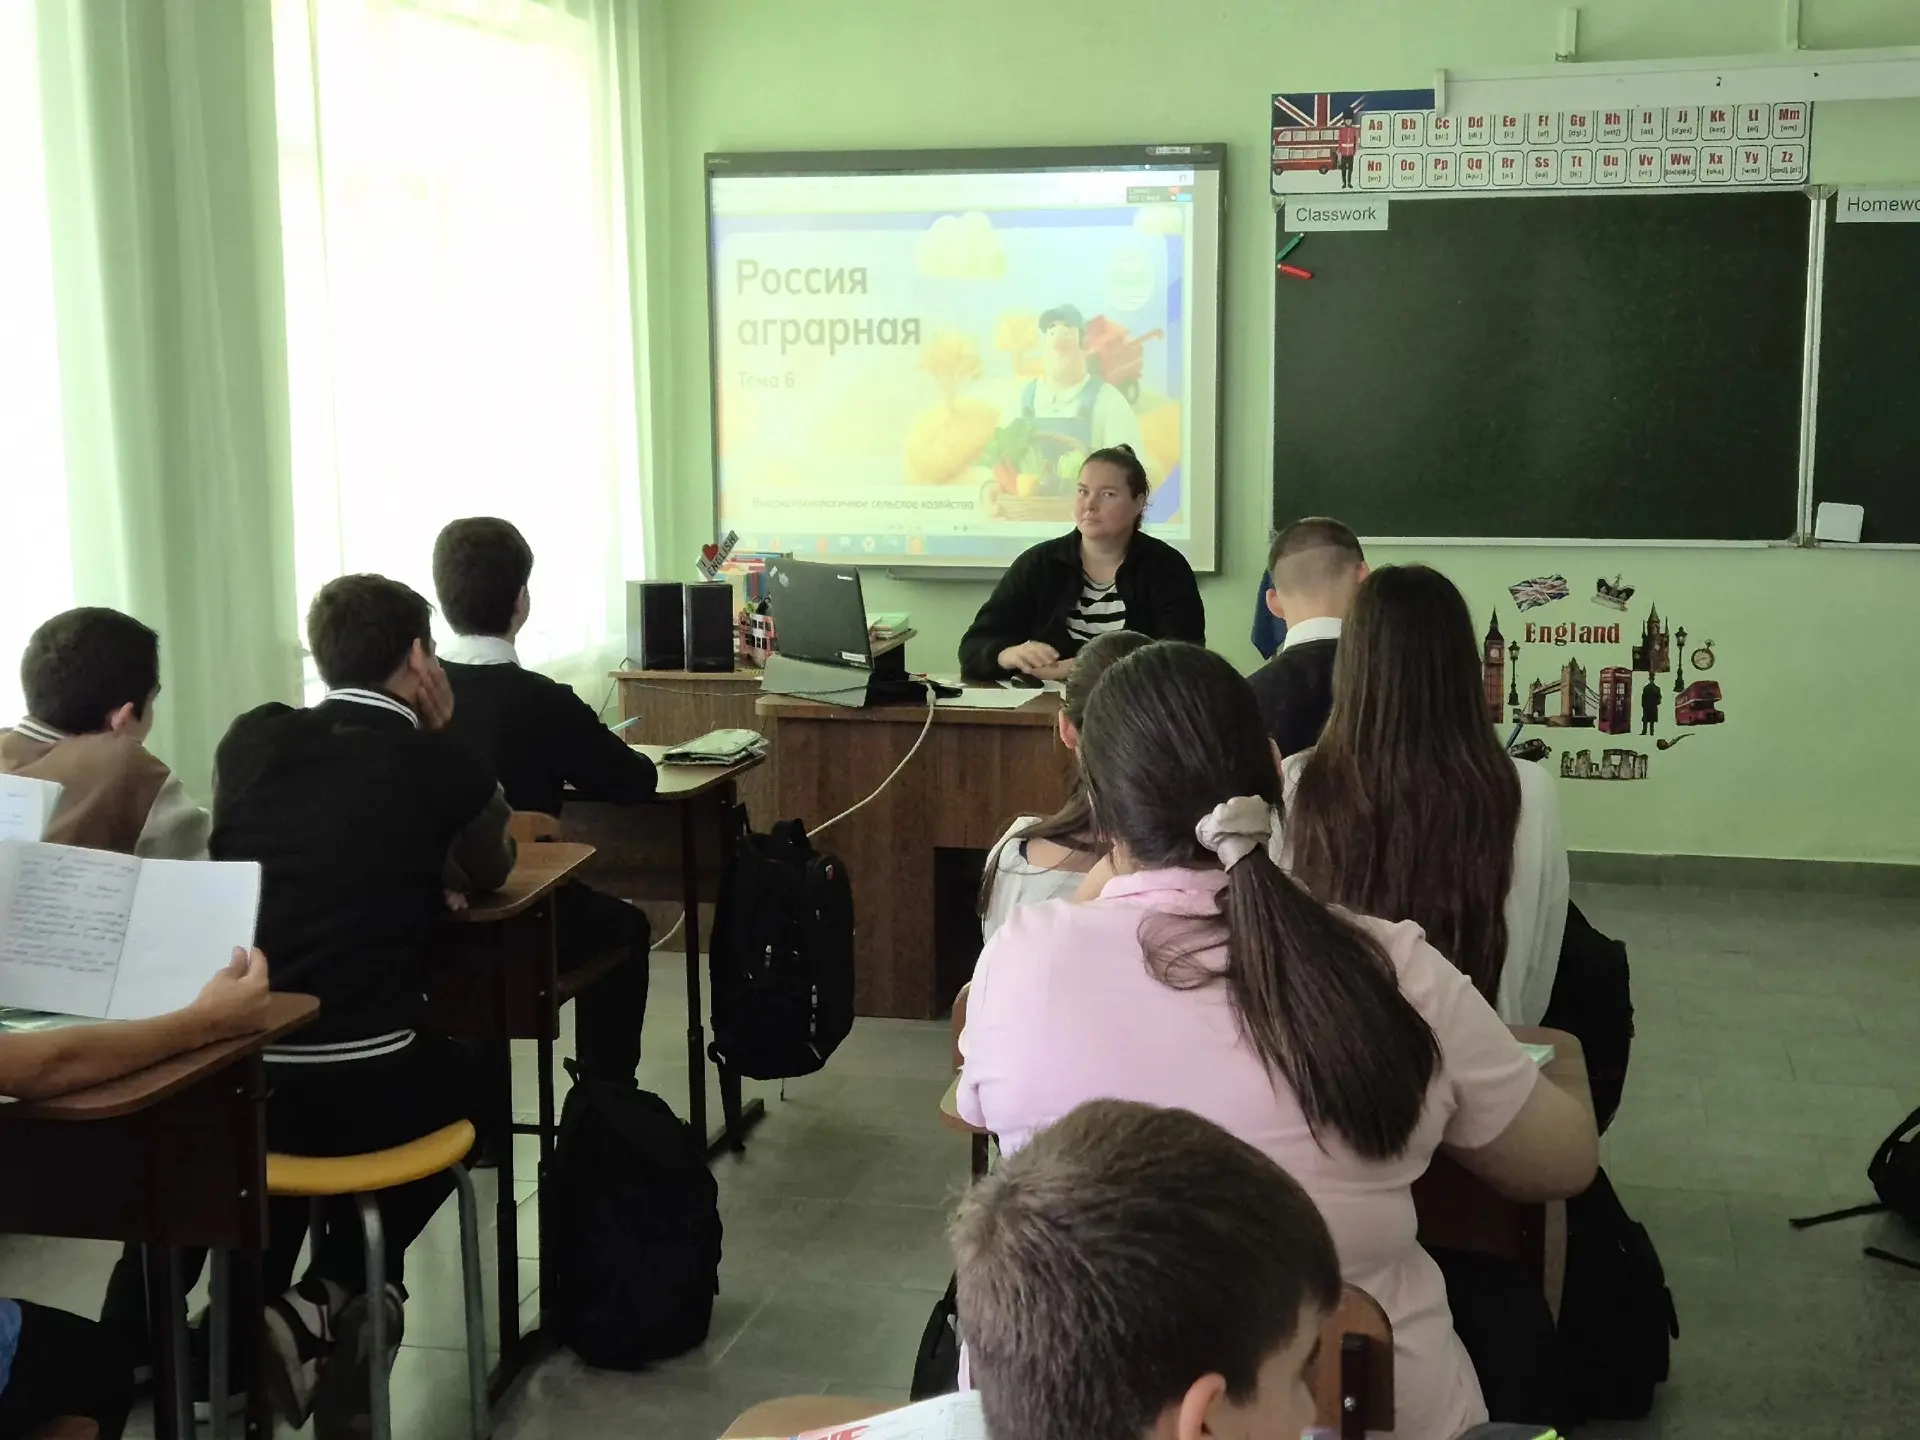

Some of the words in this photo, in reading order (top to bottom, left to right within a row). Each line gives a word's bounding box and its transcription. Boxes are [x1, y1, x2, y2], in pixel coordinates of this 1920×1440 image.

[1369, 119, 1383, 130] Aa
[1401, 118, 1416, 130] Bb
[1435, 117, 1450, 129] Cc
[1468, 116, 1483, 128] Dd
[1502, 115, 1516, 127] Ee
[1538, 115, 1549, 127] Ff
[1570, 114, 1586, 127] Gg
[1605, 113, 1620, 125] Hh
[1643, 112, 1652, 124] Ii
[1677, 110, 1688, 123] Jj
[1710, 110, 1725, 122] Kk
[1748, 109, 1759, 122] Ll
[1779, 108, 1800, 121] Mm
[1368, 160, 1382, 172] Nn
[1400, 160, 1416, 170] Oo
[1434, 158, 1448, 170] Pp
[1468, 158, 1482, 170] Qq
[1502, 157, 1515, 168] Rr
[1535, 156, 1550, 168] Ss
[1571, 156, 1583, 167] Tt
[1603, 155, 1619, 167] Uu
[1639, 154, 1653, 166] Vv
[1670, 154, 1691, 166] Ww
[1709, 152, 1723, 164] Xx
[1744, 151, 1759, 164] Yy
[1781, 152, 1794, 163] Zz
[1296, 206, 1376, 222] Classwork
[736, 258, 868, 295] Россия
[737, 317, 921, 356] аграрная
[785, 371, 794, 388] 6
[707, 535, 736, 577] ENGLISH
[1524, 622, 1620, 647] England
